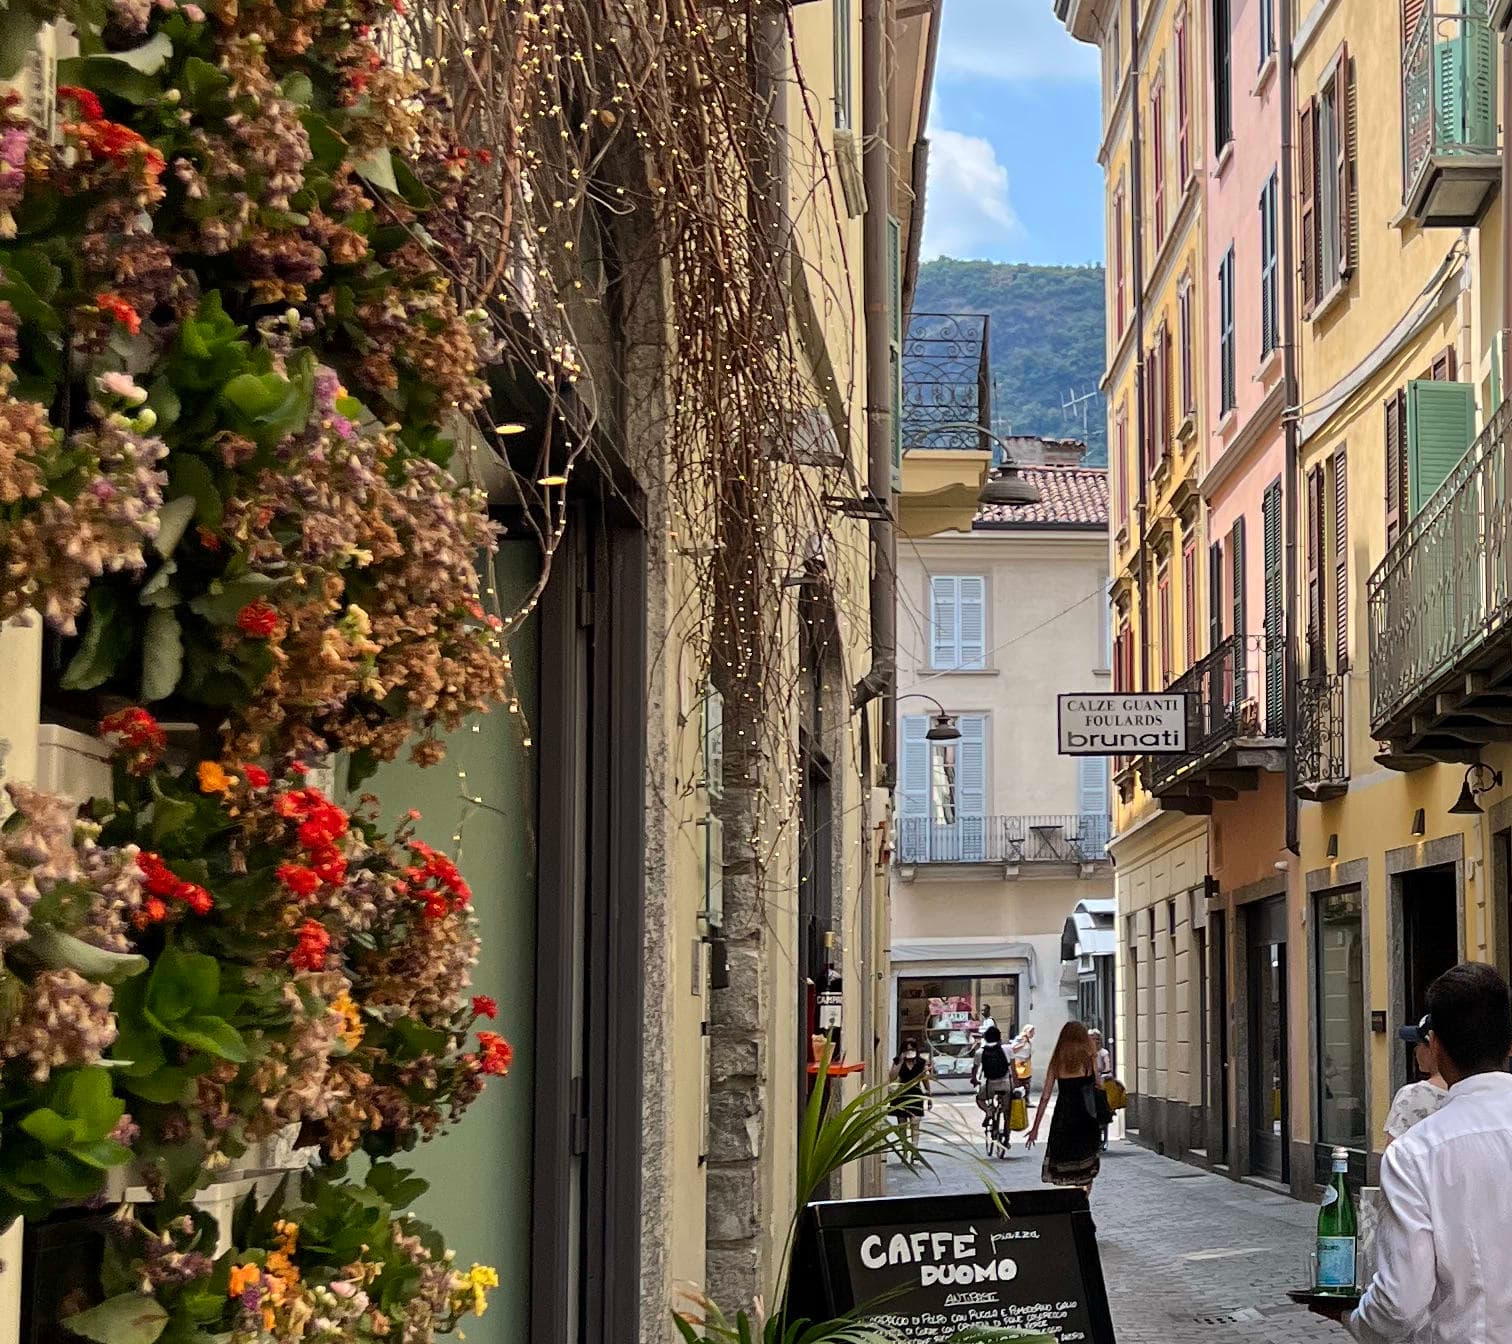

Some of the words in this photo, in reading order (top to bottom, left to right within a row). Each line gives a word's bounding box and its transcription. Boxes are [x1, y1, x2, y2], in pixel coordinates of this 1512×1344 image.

[1067, 700, 1116, 712] CALZE
[1122, 699, 1178, 711] GUANTI
[1085, 714, 1163, 727] FOULARDS
[1067, 730, 1179, 748] brunati
[860, 1225, 979, 1269] CAFFÈ
[990, 1230, 1040, 1255] piazza
[920, 1258, 1018, 1287] DUOMO
